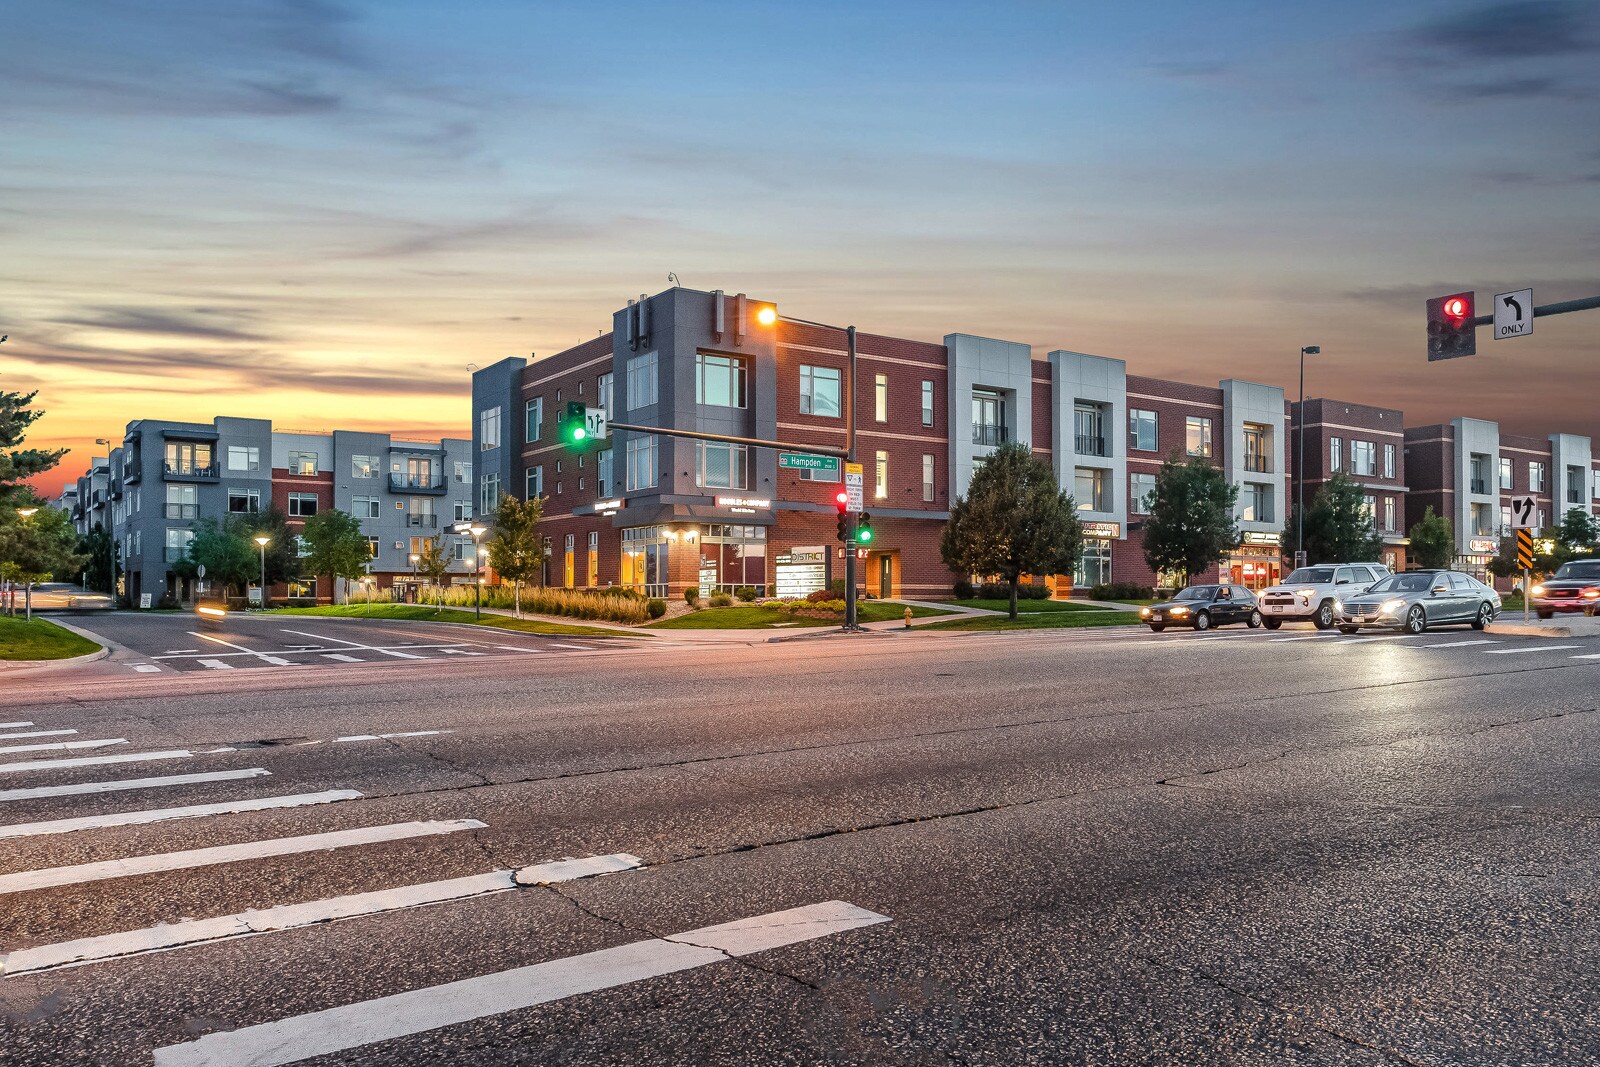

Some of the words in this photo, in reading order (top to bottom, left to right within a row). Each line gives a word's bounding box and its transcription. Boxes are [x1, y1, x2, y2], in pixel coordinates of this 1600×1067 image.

[1501, 323, 1525, 335] ONLY
[791, 456, 821, 467] Hampden
[1082, 529, 1112, 537] COMPANY
[792, 552, 825, 561] DISTRICT
